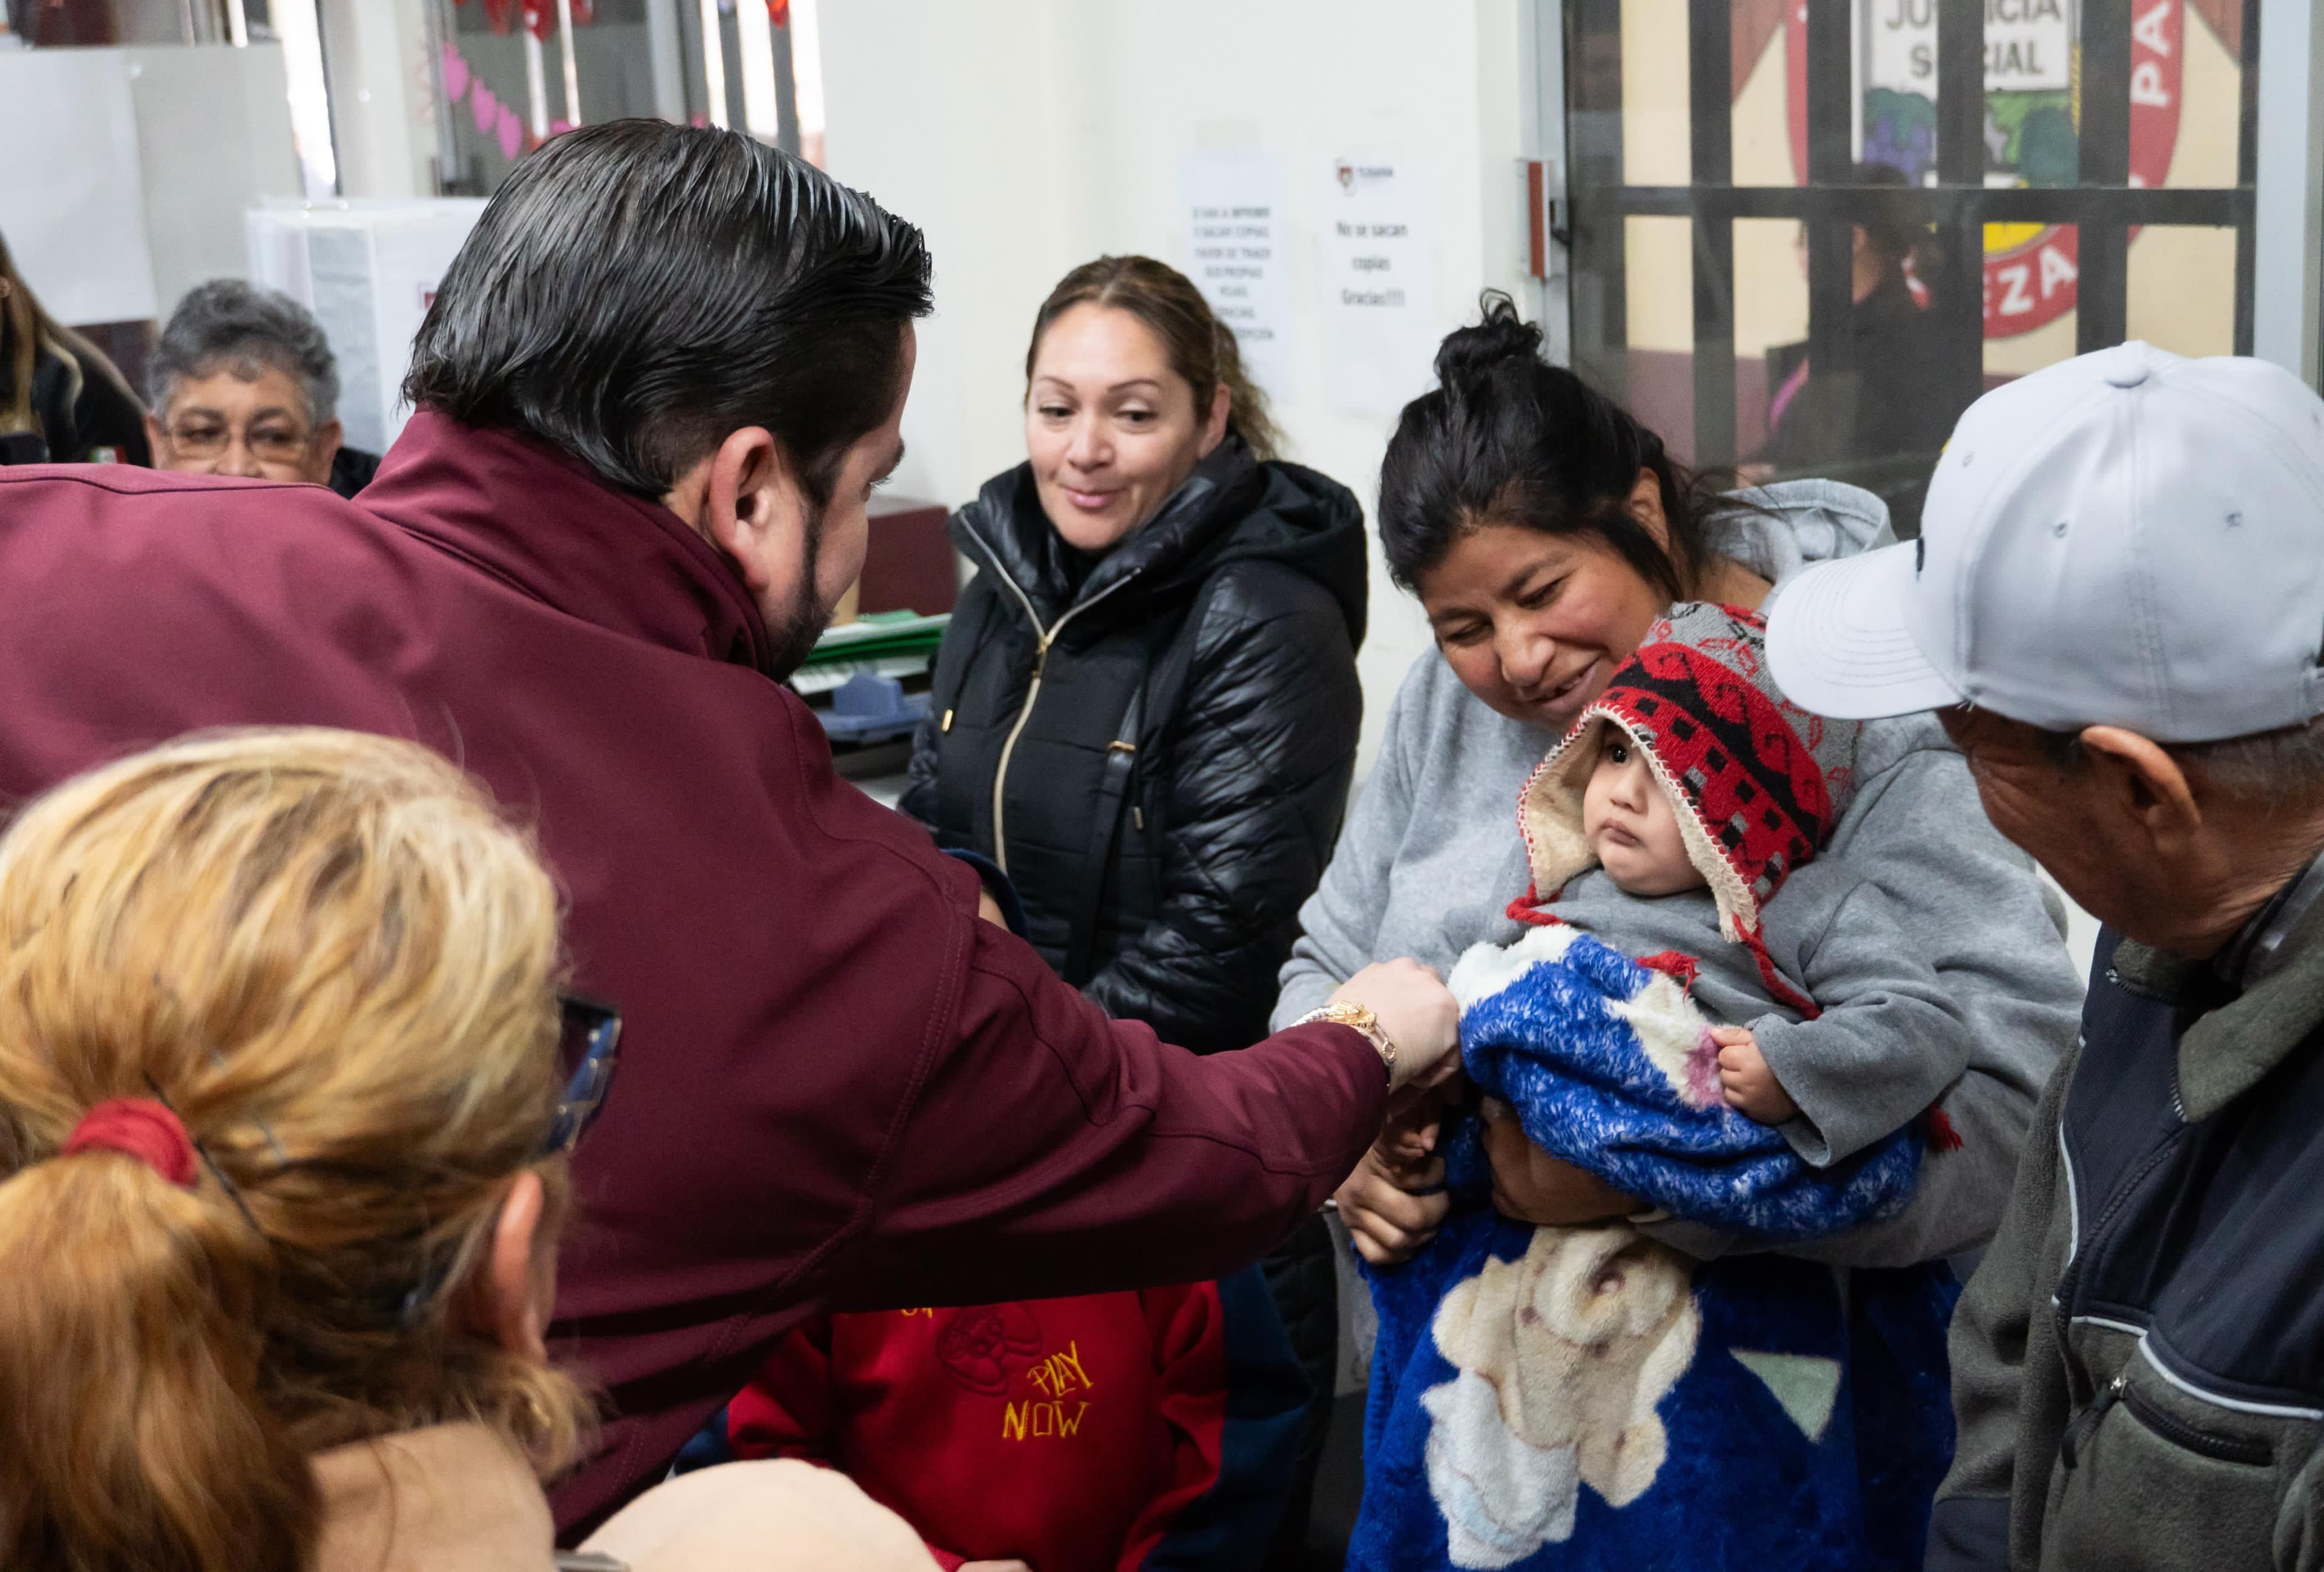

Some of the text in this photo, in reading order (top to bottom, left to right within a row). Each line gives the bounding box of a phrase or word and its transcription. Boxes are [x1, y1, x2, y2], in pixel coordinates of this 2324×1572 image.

[1884, 0, 2061, 28] JUICIA
[1910, 41, 2045, 79] SIAL
[1983, 245, 2079, 318] ZA
[1026, 1340, 1094, 1397] PLAY
[1002, 1399, 1091, 1441] NOW
